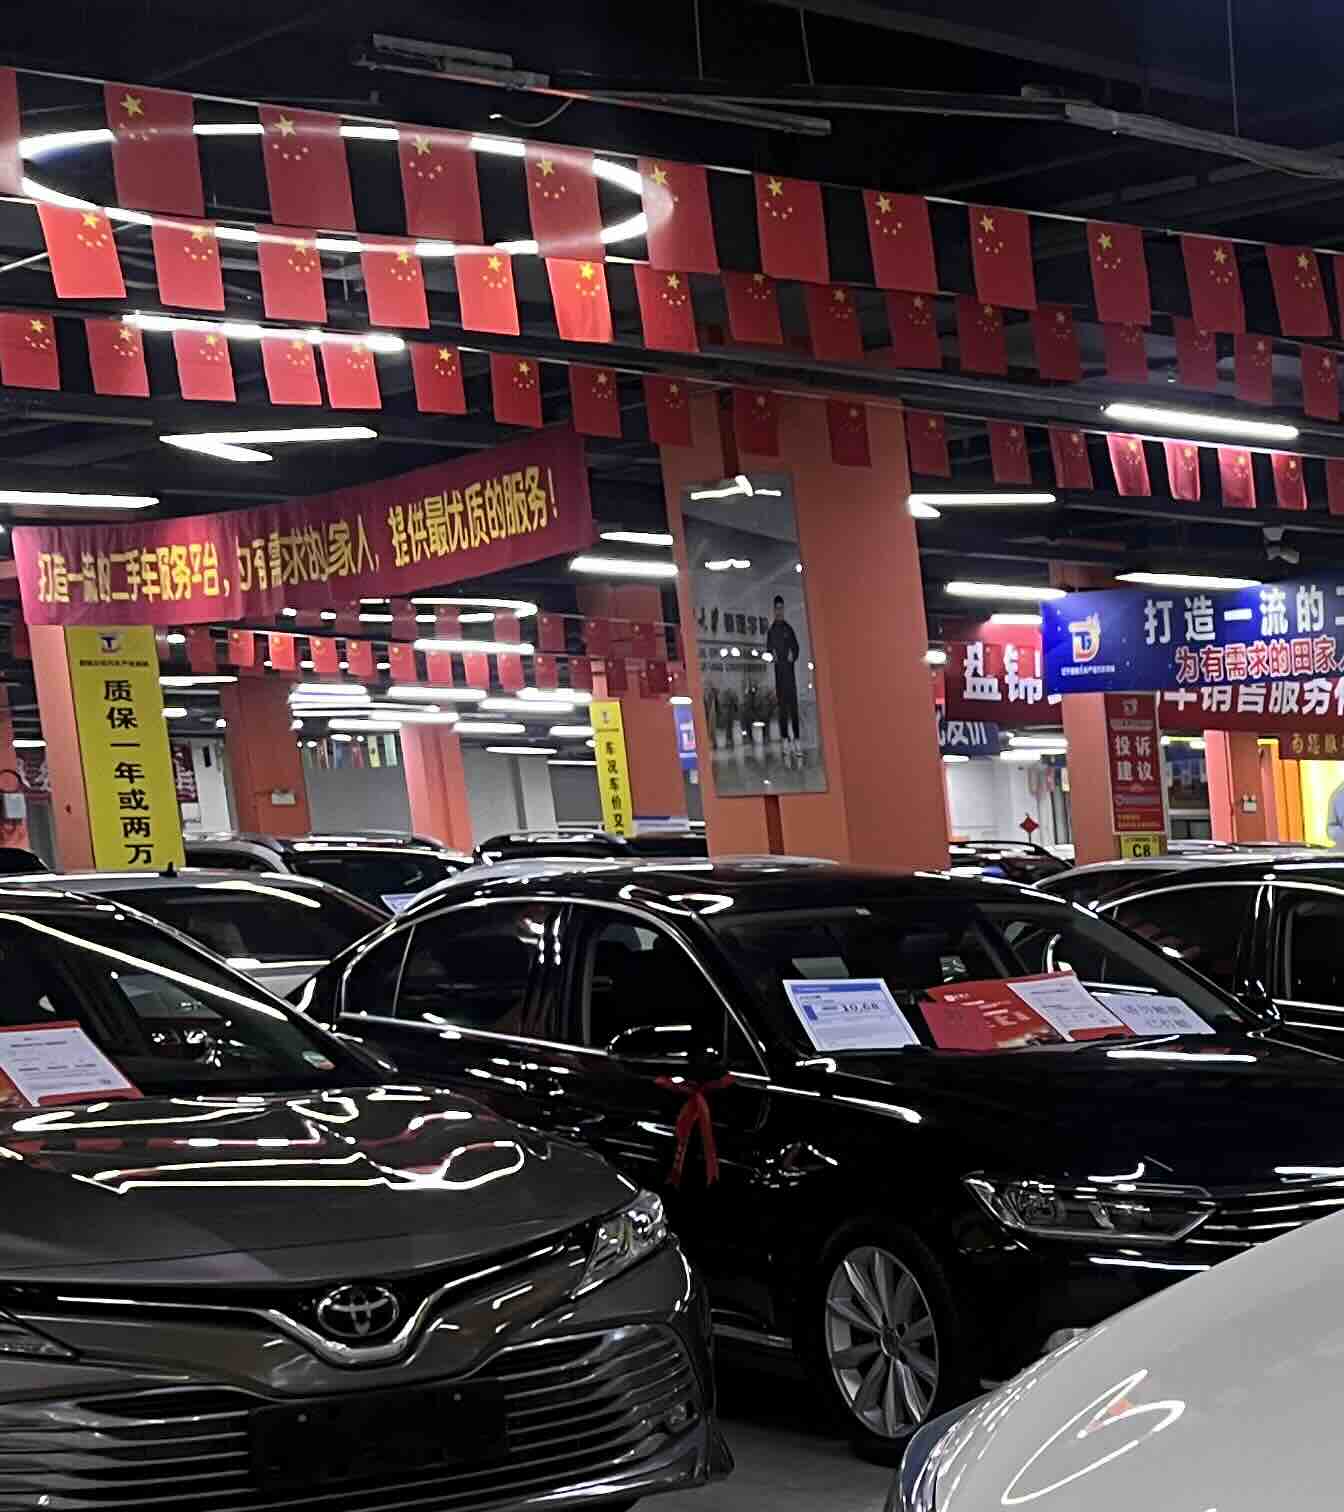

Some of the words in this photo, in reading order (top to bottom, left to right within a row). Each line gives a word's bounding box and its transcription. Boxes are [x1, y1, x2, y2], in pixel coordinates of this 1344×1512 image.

[103, 679, 155, 865] 质保一年或两万
